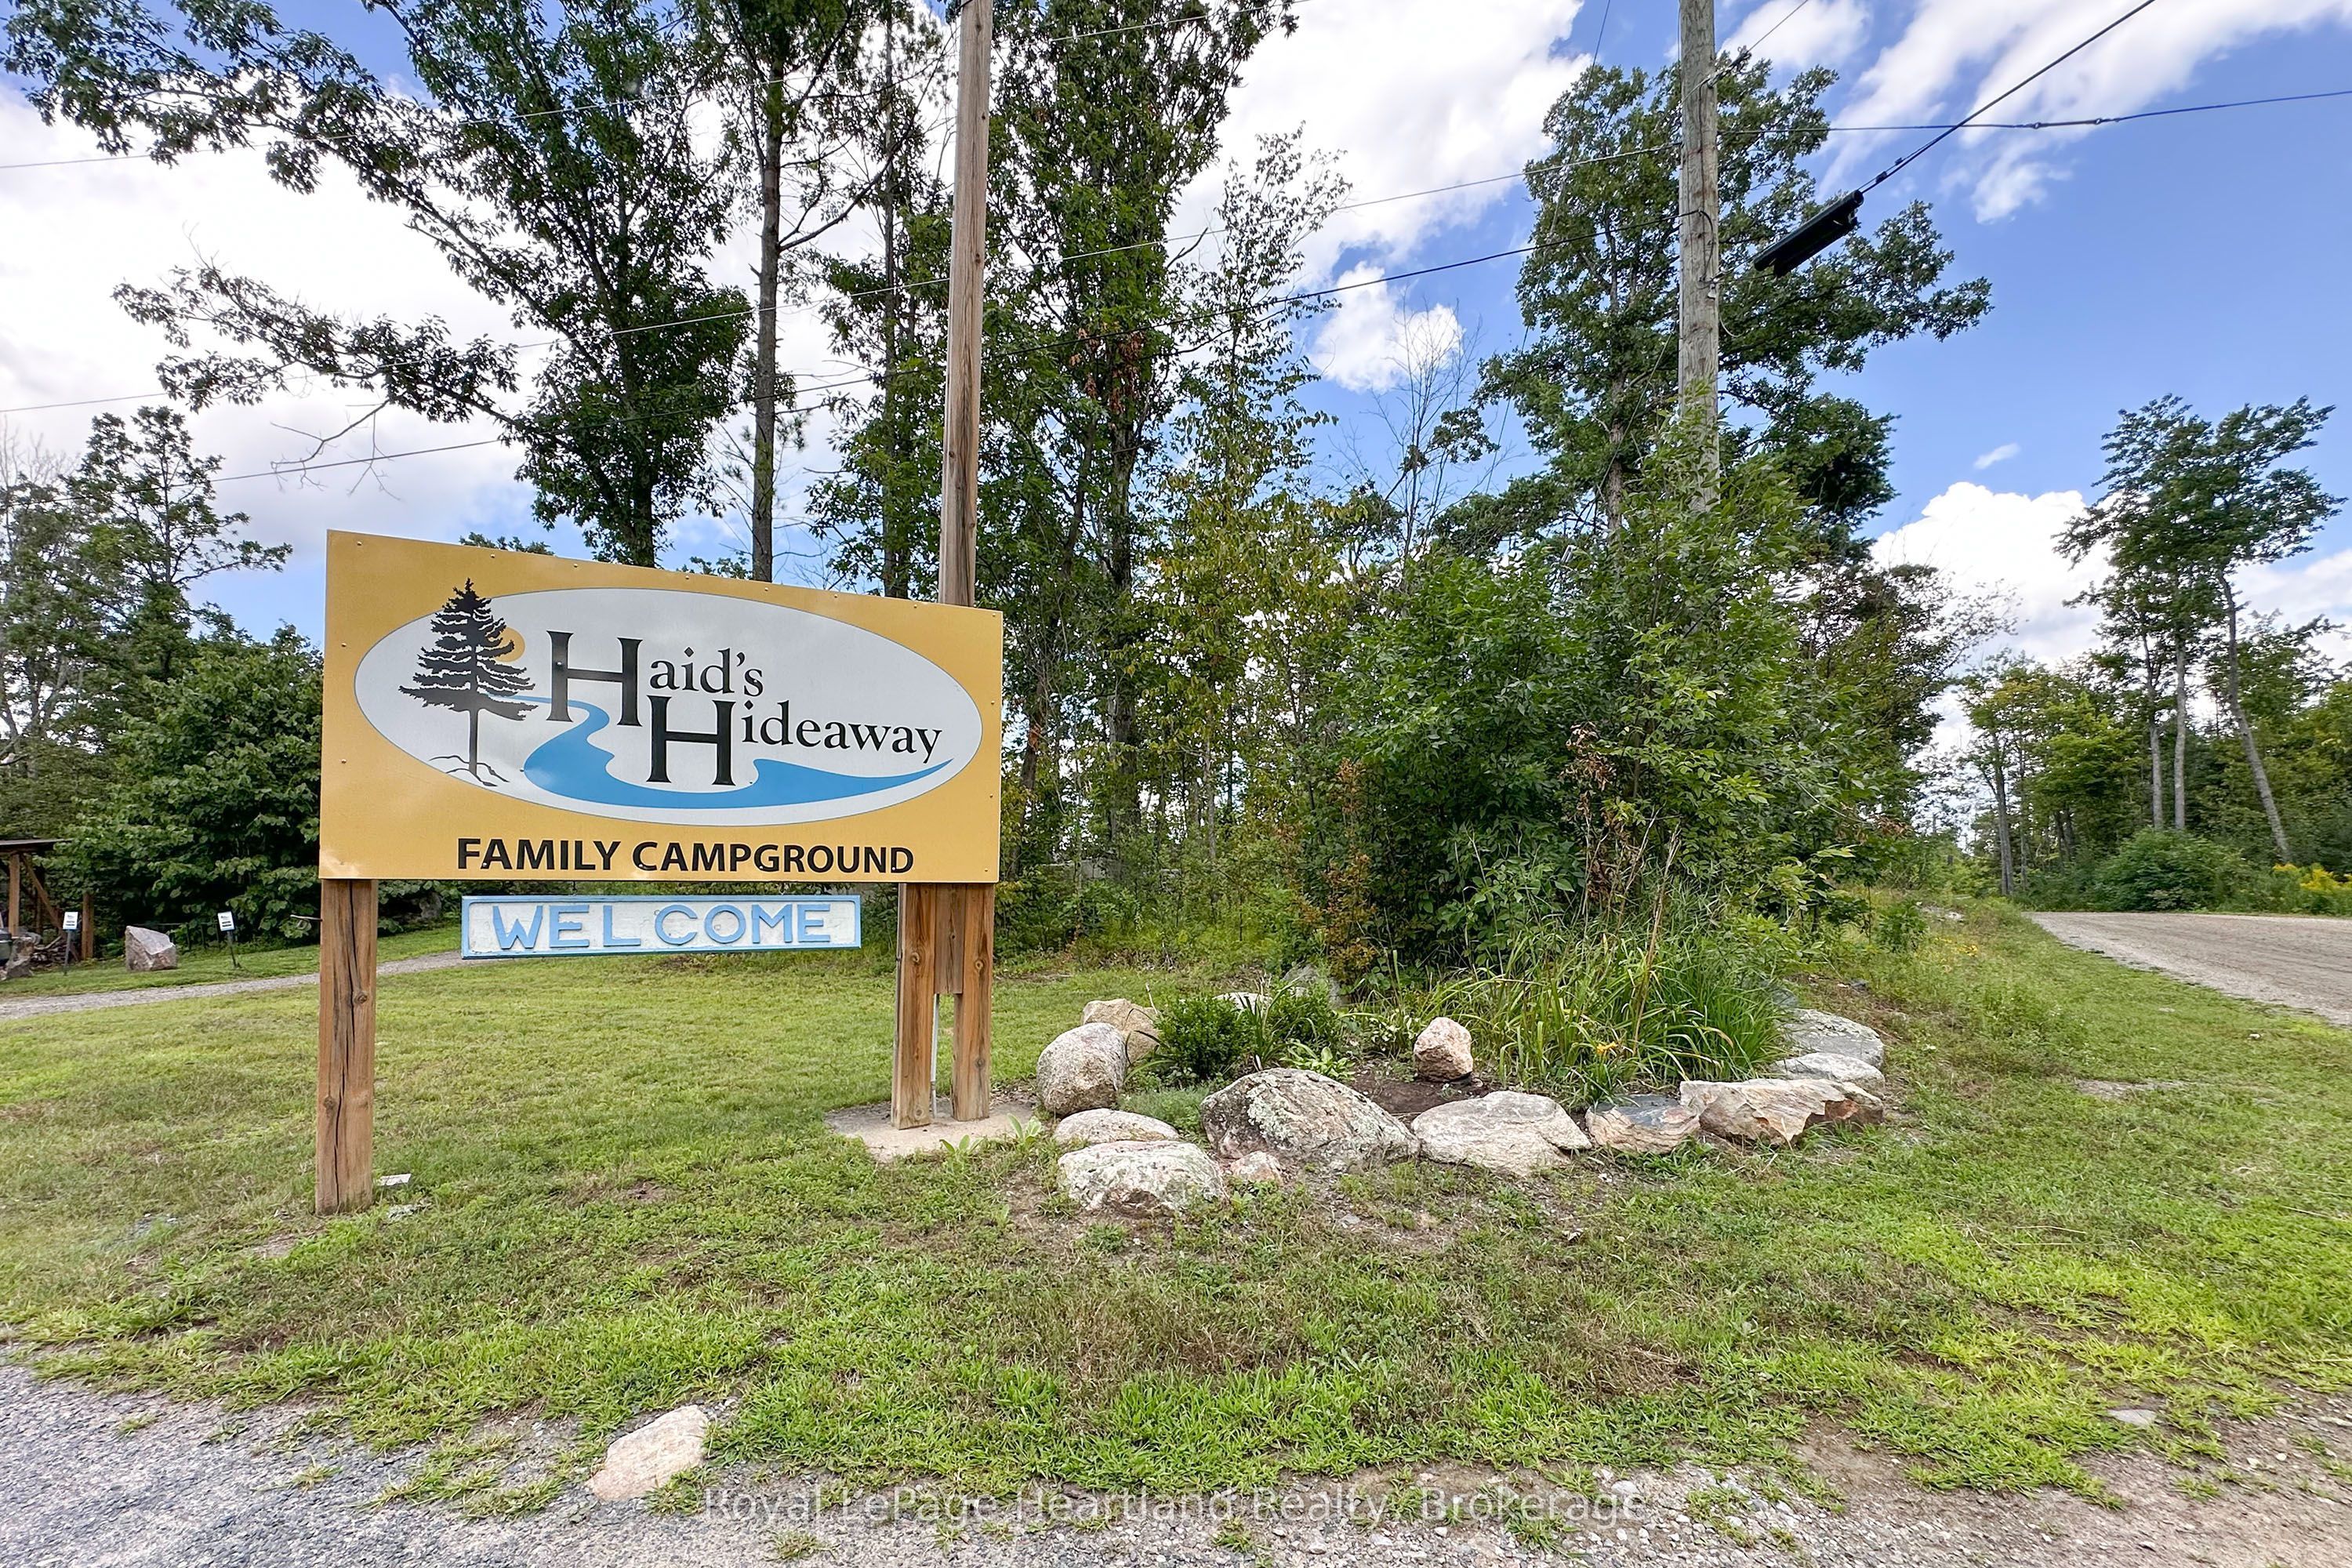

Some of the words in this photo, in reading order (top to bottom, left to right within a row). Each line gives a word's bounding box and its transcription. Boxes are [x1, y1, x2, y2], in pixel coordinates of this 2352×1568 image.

[546, 630, 764, 727] Haid's
[647, 695, 942, 786] Hideaway
[457, 837, 621, 872] FAMILY
[632, 840, 914, 873] CAMPGROUND
[492, 903, 832, 950] WELCOME
